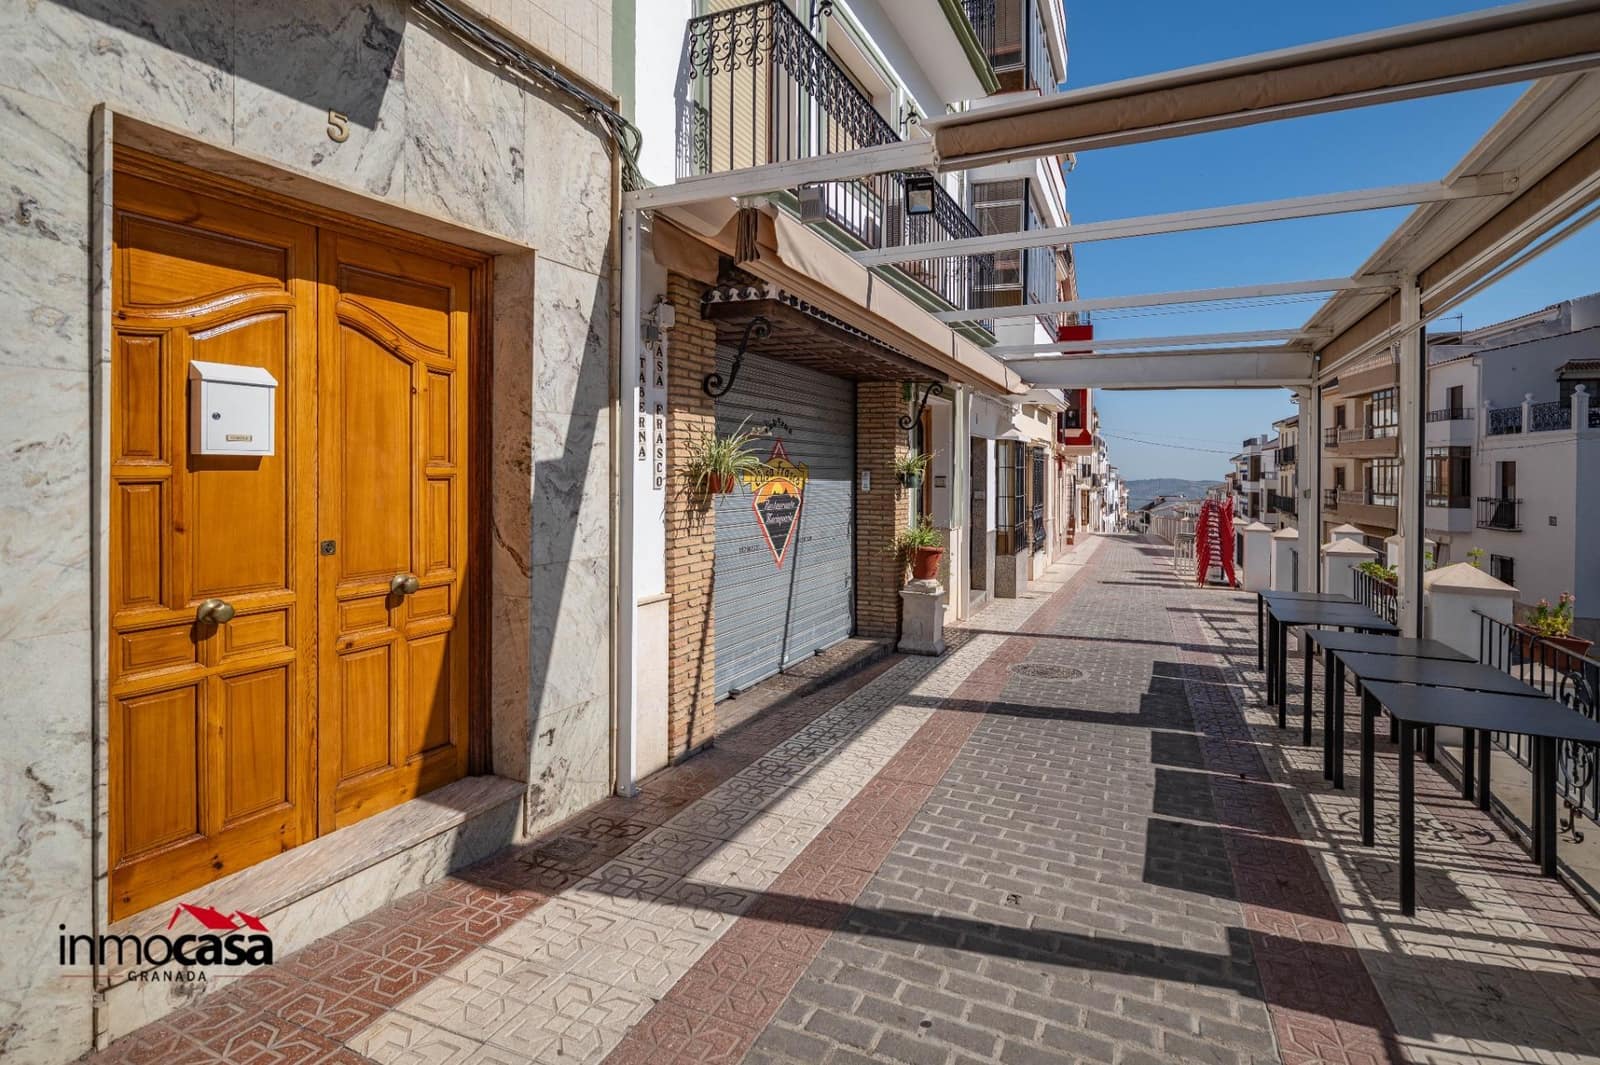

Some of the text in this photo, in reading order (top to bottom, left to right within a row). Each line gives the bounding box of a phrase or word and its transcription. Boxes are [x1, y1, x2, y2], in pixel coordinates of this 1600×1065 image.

[327, 107, 350, 143] 5
[639, 357, 647, 457] TABERNA
[655, 404, 664, 487] FRASCO
